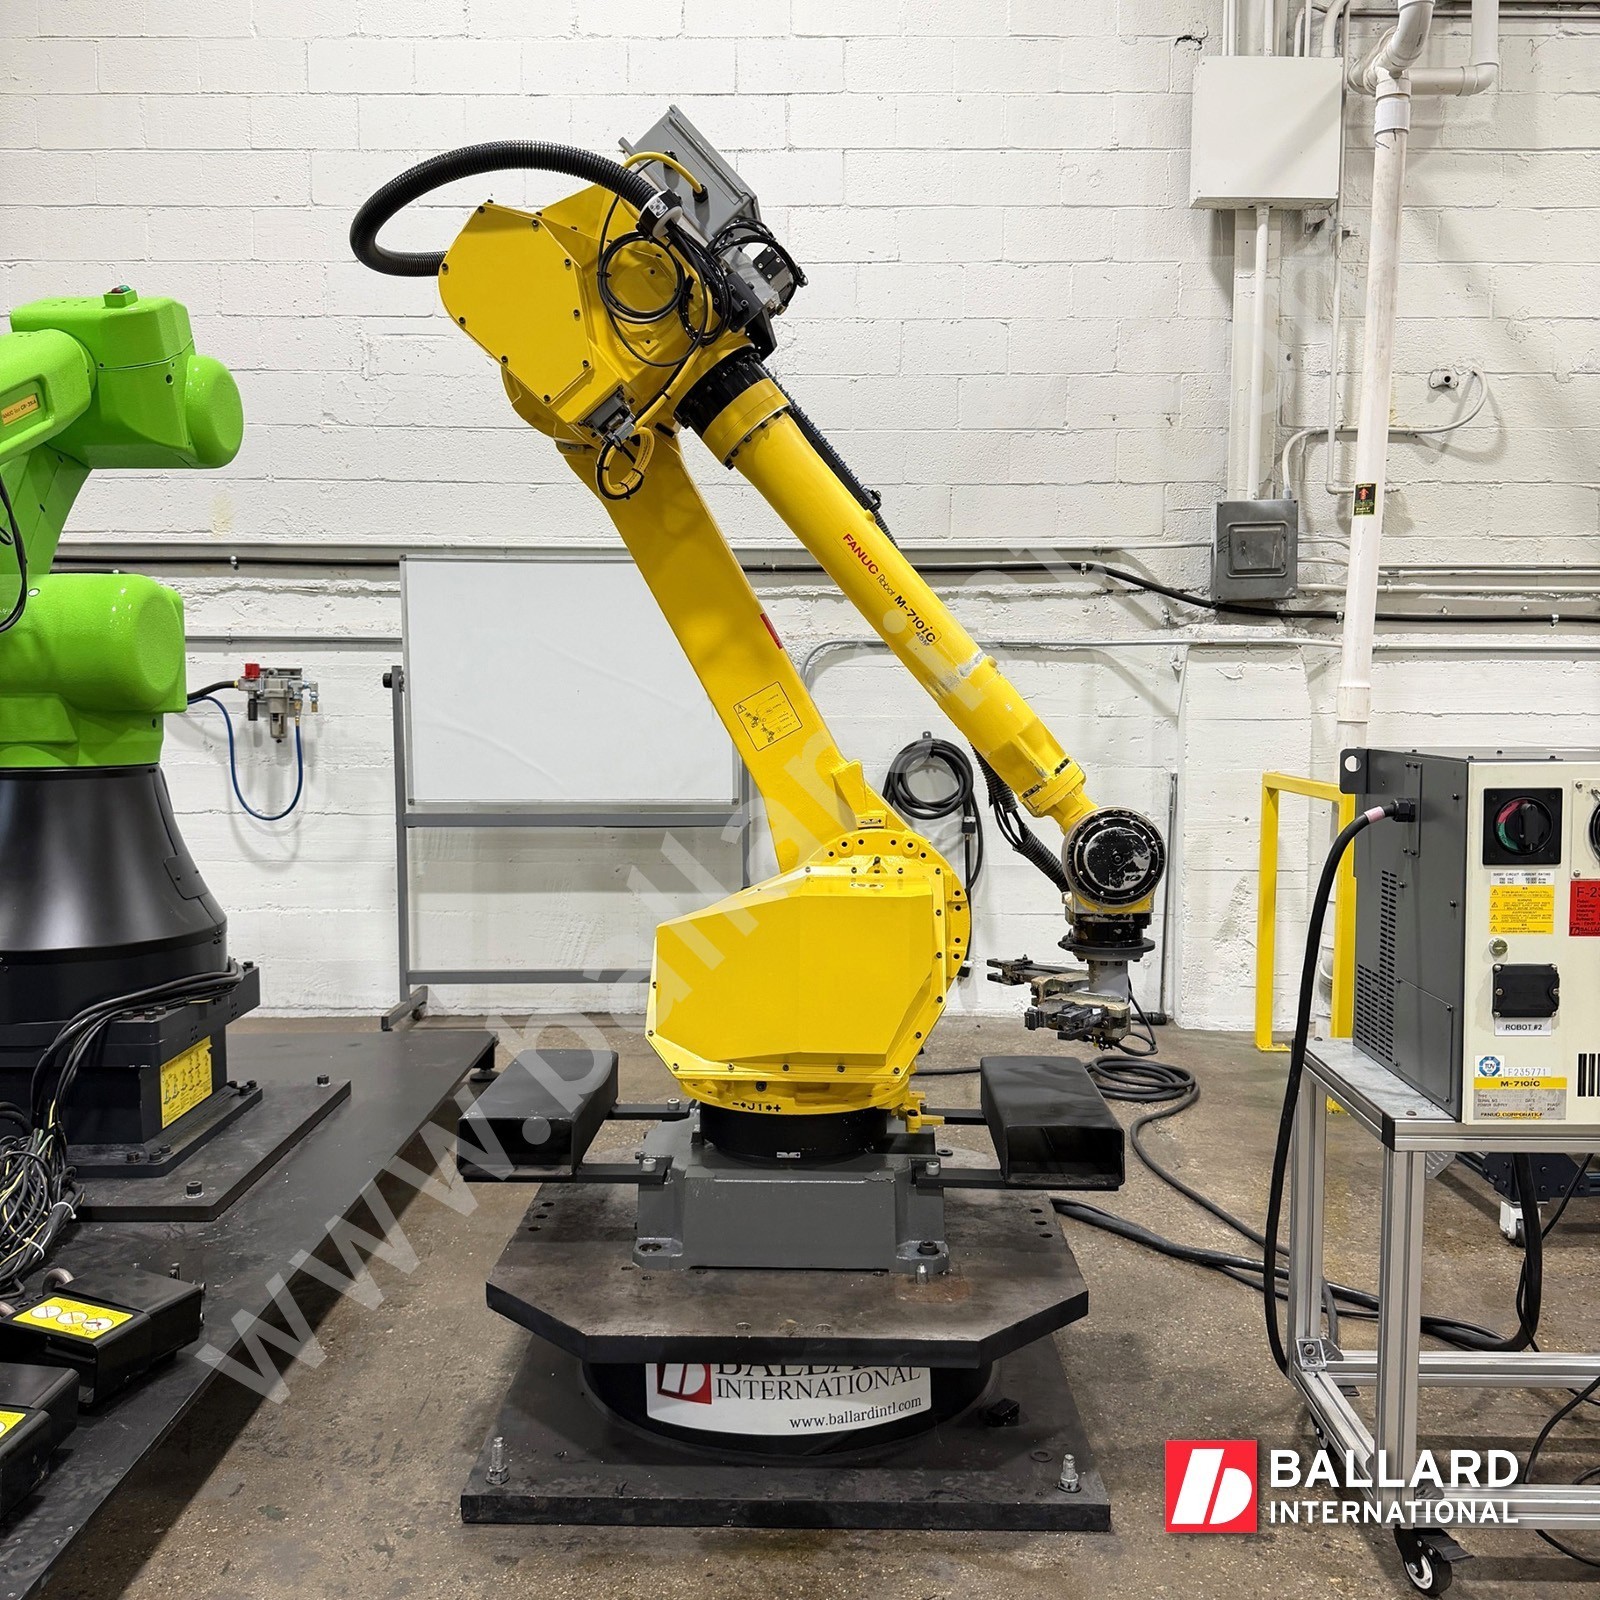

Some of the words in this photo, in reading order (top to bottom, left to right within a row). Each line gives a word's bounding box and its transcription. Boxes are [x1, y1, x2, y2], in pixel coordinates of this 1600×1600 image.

[842, 533, 878, 575] FANUC
[877, 573, 896, 596] Robot
[894, 595, 936, 643] M-710iC
[1576, 886, 1600, 898] F-2
[1505, 1023, 1531, 1031] ROBOT
[1533, 1023, 1543, 1031] #2
[1500, 1078, 1541, 1087] M-710iC
[715, 1366, 921, 1401] INTERNATIONAL
[789, 1396, 922, 1429] www.ballardintl.com
